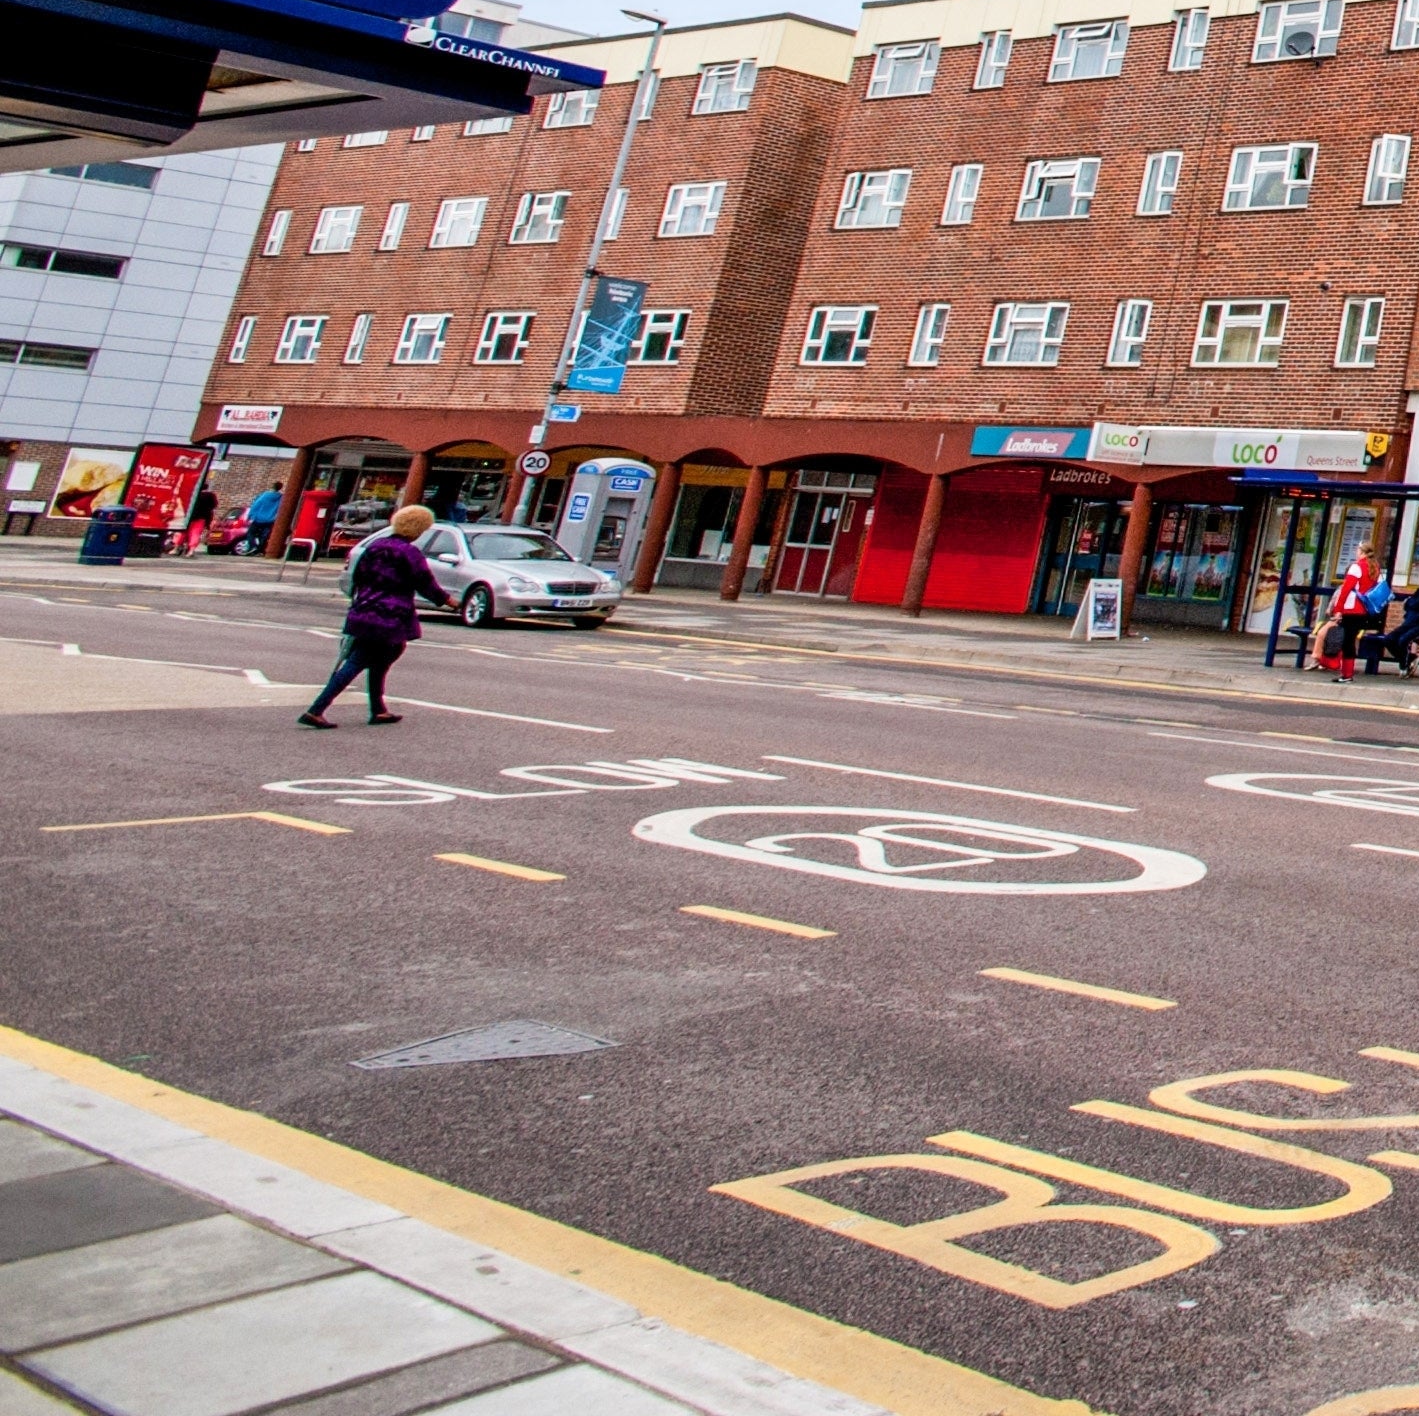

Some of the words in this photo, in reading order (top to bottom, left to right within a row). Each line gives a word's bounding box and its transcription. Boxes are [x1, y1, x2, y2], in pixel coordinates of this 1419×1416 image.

[1006, 437, 1059, 453] Ladbrokes
[526, 456, 548, 469] 20
[1306, 454, 1334, 467] Queens
[1335, 456, 1358, 467] Street
[138, 465, 170, 478] WIN
[1050, 468, 1112, 485] Ladbrokes
[614, 478, 639, 486] CASH
[261, 756, 788, 806] SLOW
[743, 822, 1080, 874] 20
